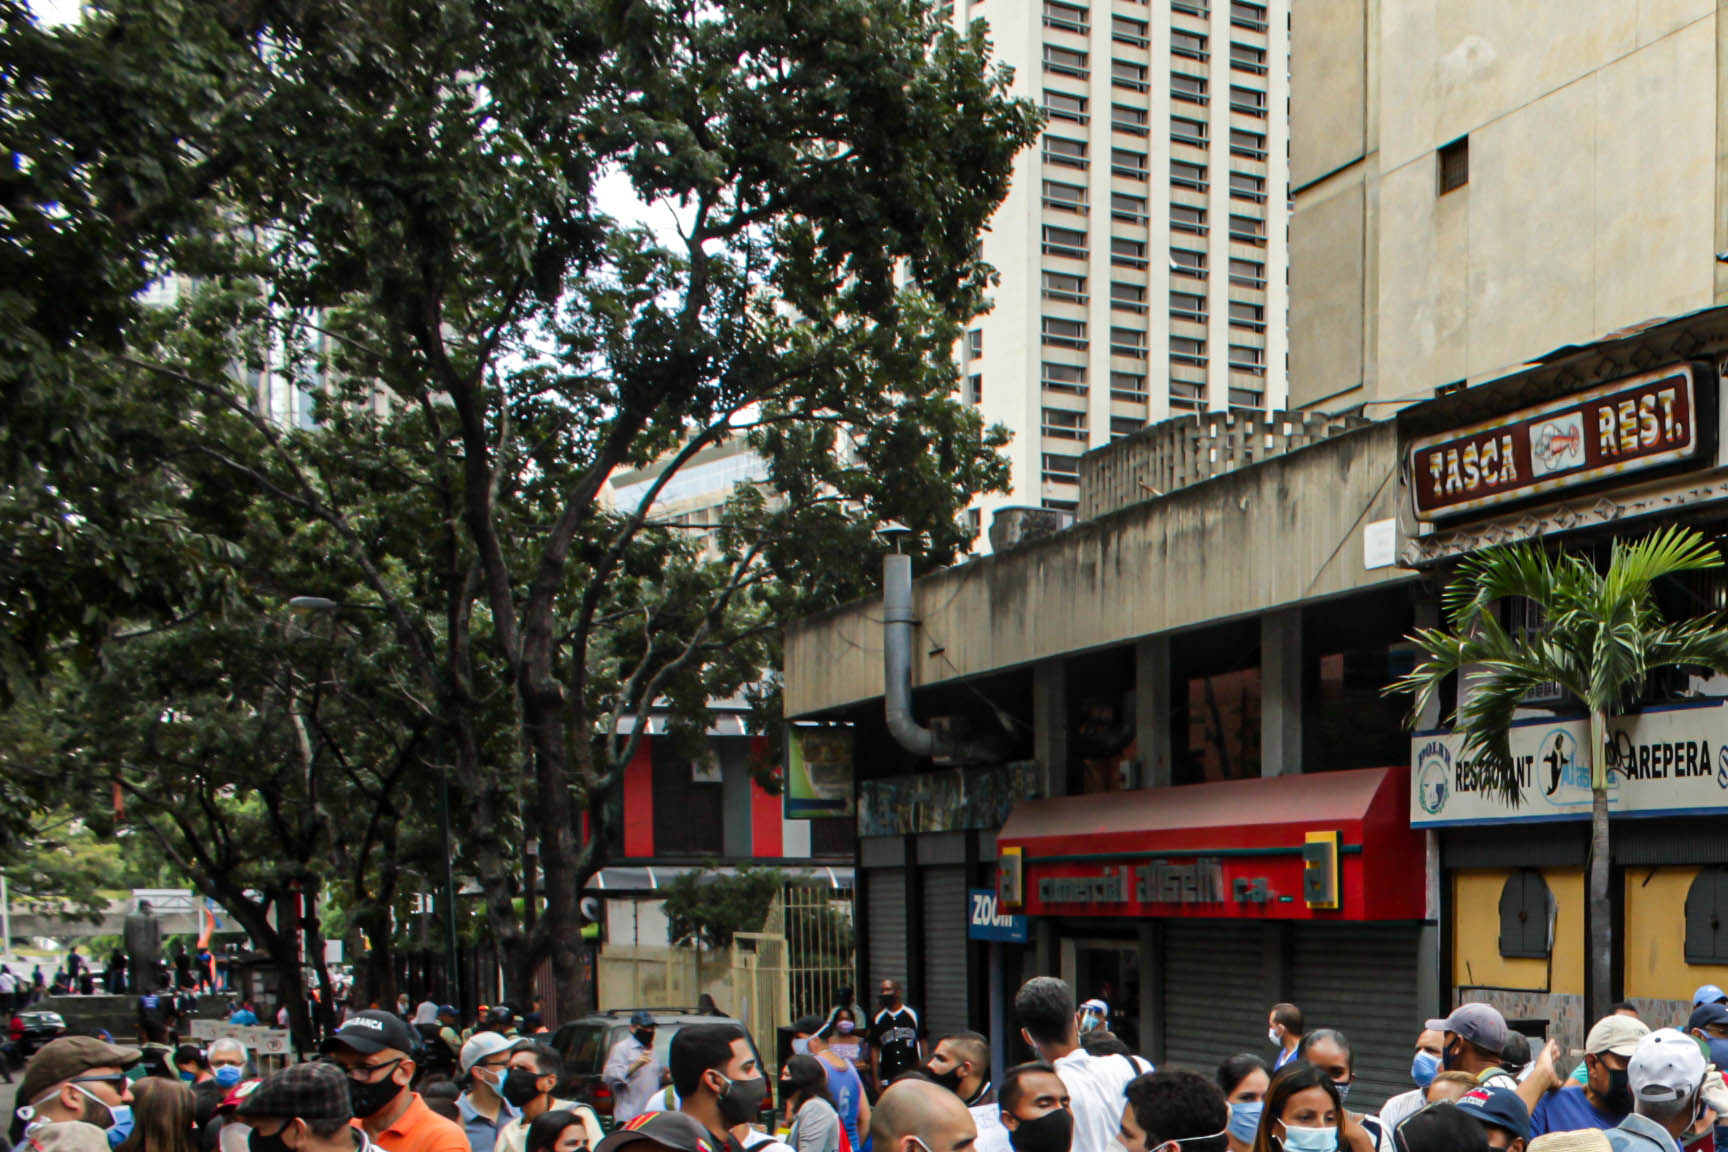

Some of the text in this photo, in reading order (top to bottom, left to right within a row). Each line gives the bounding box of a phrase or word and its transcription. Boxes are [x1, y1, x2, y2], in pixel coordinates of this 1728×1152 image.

[1428, 387, 1684, 497] TASCA REST.
[1626, 740, 1712, 781] AREPERA
